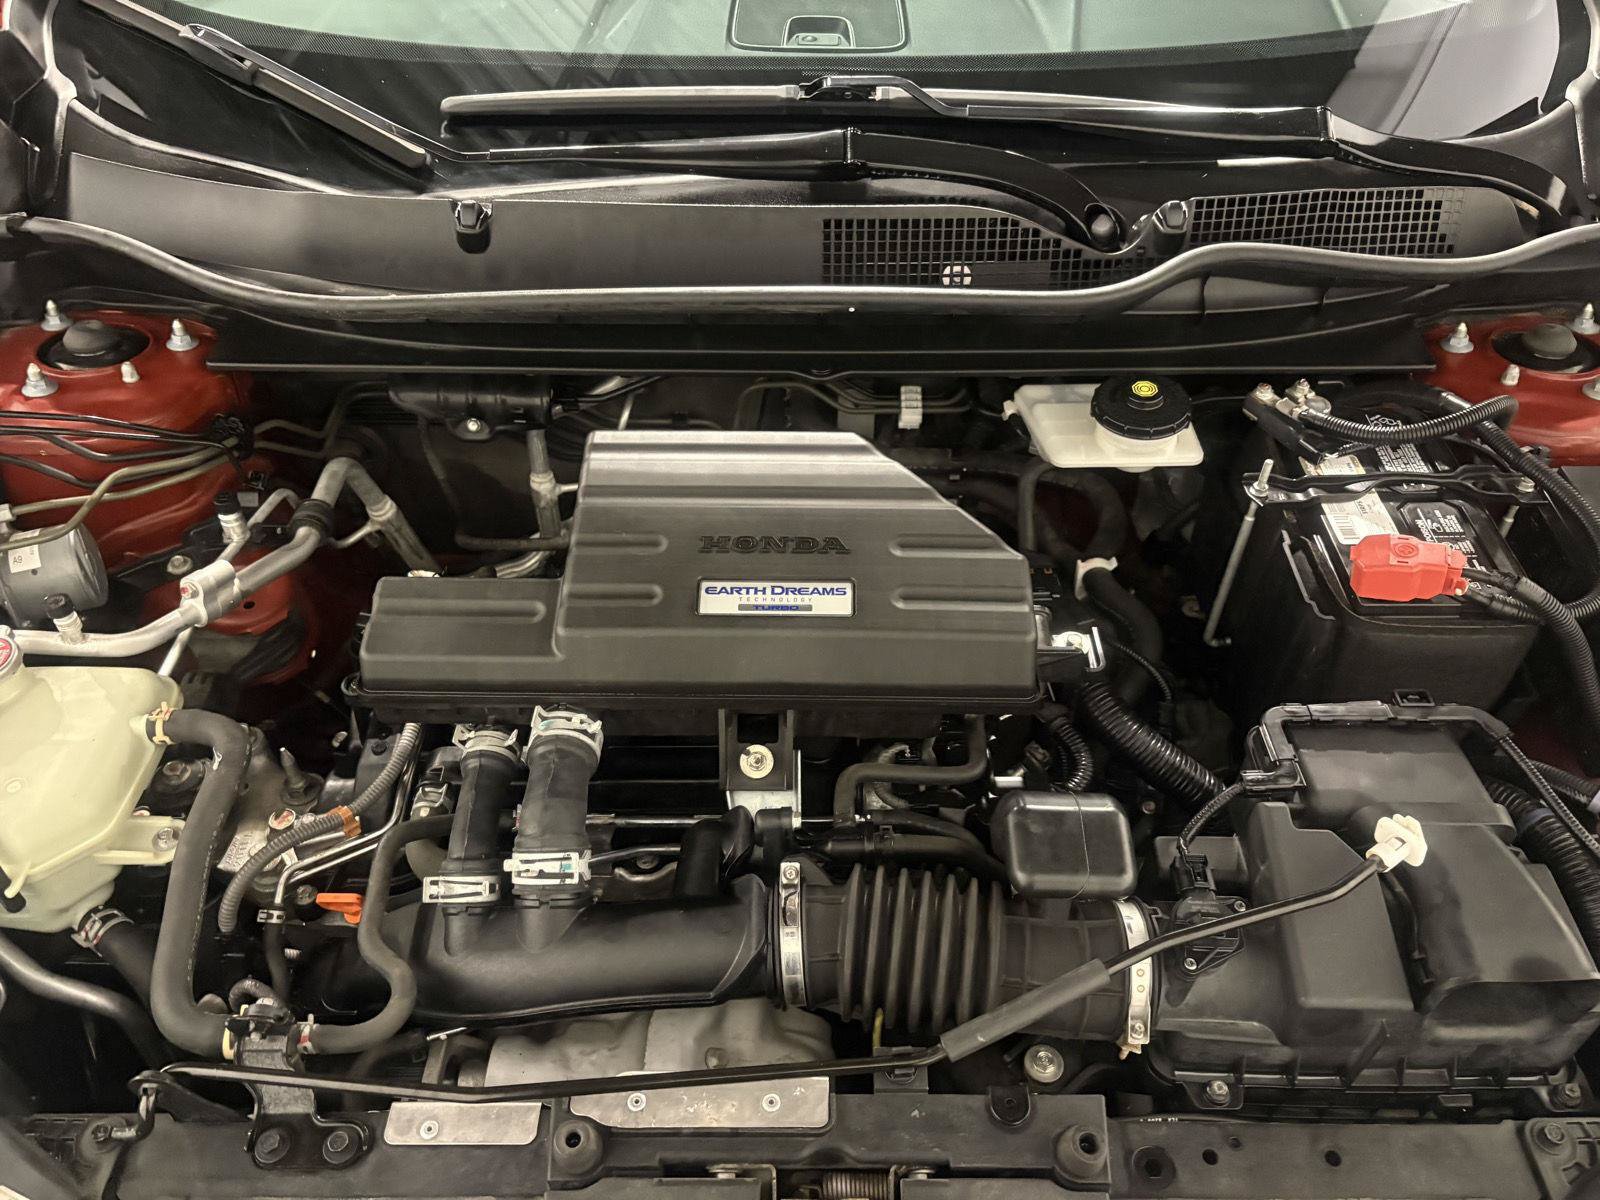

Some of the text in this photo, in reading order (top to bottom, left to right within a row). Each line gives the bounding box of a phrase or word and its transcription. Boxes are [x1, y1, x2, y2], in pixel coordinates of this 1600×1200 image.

[699, 535, 851, 554] HONDA
[704, 585, 847, 595] EARTH DREAMS
